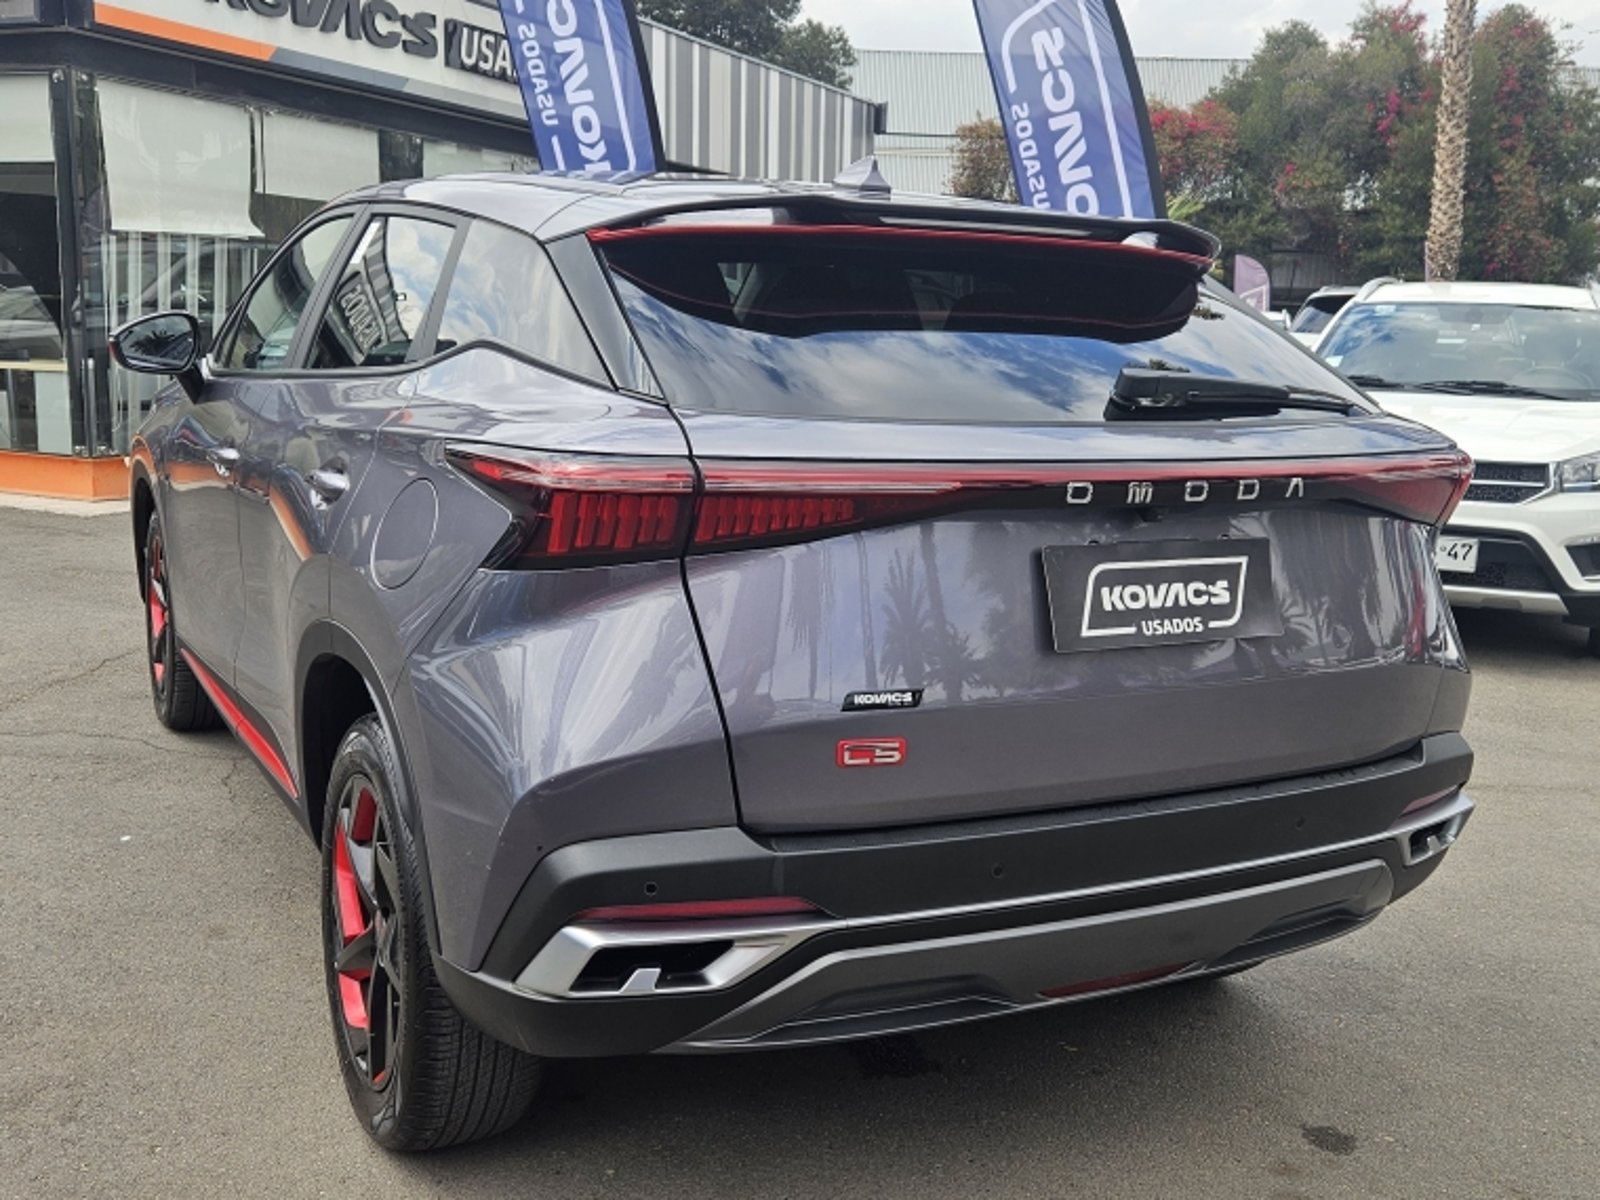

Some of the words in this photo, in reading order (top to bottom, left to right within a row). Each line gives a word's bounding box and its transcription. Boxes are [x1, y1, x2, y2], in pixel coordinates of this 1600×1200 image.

[460, 27, 517, 78] USA
[1066, 477, 1305, 504] OMODA
[1447, 542, 1473, 561] 47
[1100, 580, 1231, 611] KOVACS
[1141, 616, 1205, 636] USADOS
[854, 692, 913, 705] KOVACS
[843, 741, 902, 765] C5
